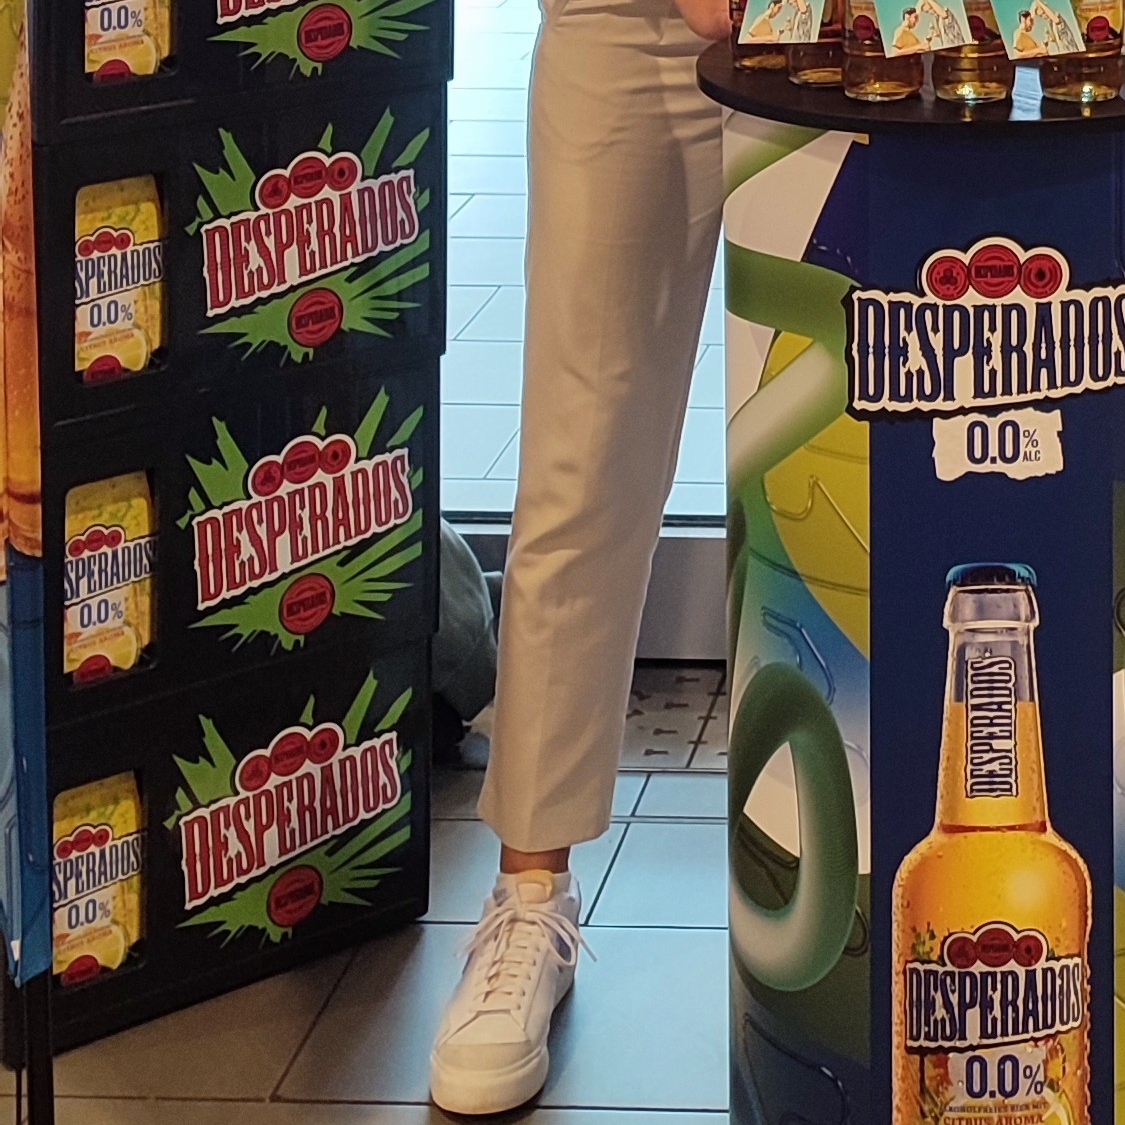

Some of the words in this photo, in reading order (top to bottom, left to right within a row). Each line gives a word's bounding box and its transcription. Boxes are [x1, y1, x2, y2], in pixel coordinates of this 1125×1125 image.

[99, 5, 143, 33] 0.0%
[204, 176, 416, 312] DESPERADOS
[89, 300, 133, 328] 0.0%
[966, 419, 1040, 465] 0.0%
[1022, 450, 1041, 463] ALC
[196, 454, 410, 604] DESPERADOS
[79, 598, 123, 629] 0.0%
[969, 657, 1014, 796] DESPERADOS
[182, 737, 399, 903] DESPERADOS
[67, 898, 111, 930] 0.0%
[908, 962, 1082, 1043] DESPERADOS
[965, 1054, 1045, 1099] 0.0%
